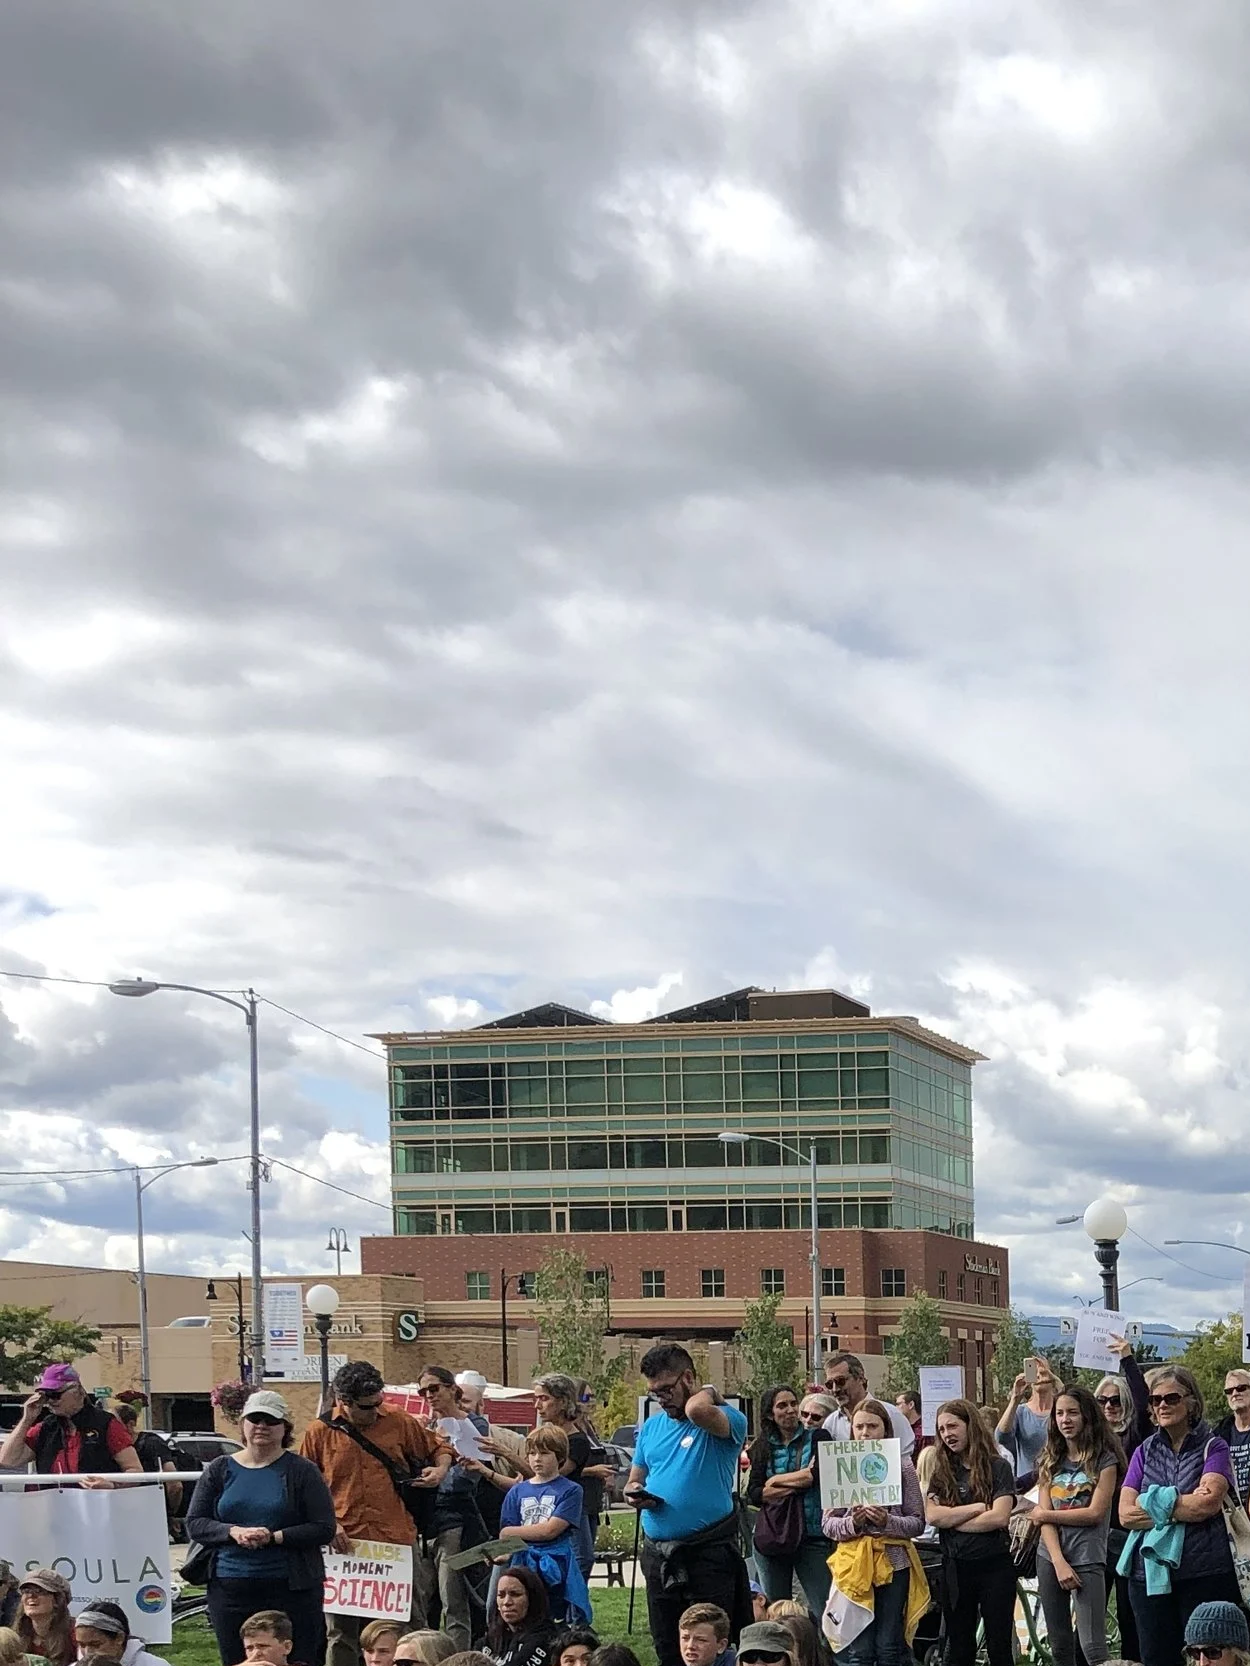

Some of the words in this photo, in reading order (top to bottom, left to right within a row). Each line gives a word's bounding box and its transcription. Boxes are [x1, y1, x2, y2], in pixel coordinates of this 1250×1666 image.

[823, 1441, 866, 1456] THERE
[871, 1440, 883, 1452] IS
[829, 1486, 887, 1506] PLANET
[342, 1560, 393, 1576] MOMENT
[323, 1577, 411, 1613] SCIENCE!
